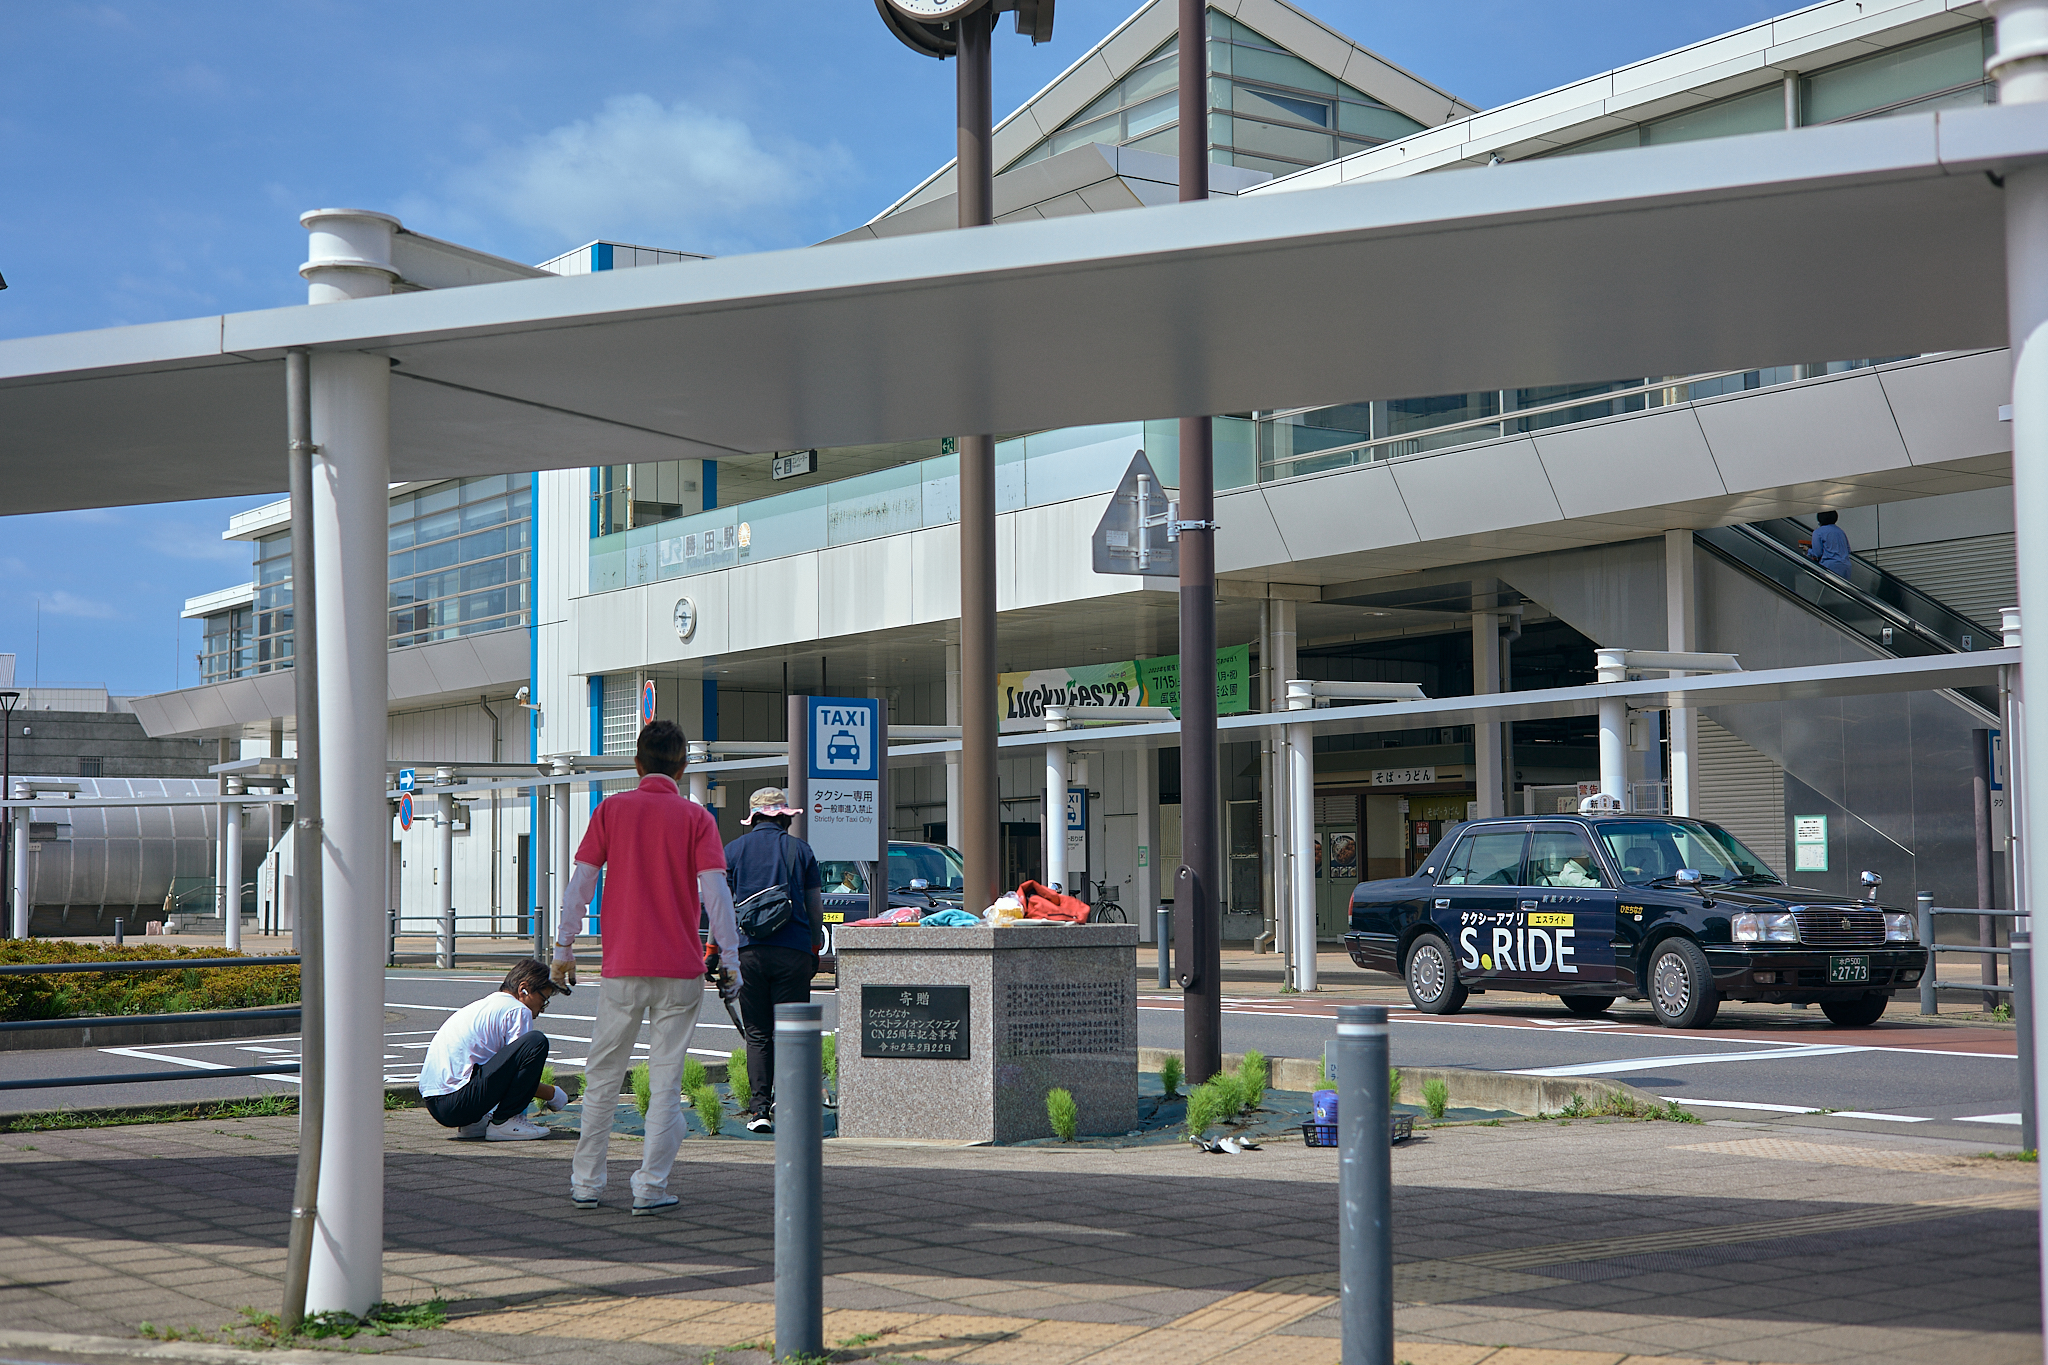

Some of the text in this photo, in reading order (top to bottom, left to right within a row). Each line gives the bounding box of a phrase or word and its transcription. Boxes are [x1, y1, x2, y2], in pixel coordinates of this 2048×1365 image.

[685, 525, 735, 557] 勝田駅
[660, 537, 684, 566] JR
[820, 709, 865, 727] TAXI
[1375, 769, 1431, 784] そば・うどん
[814, 790, 873, 802] タクシー専用
[1578, 784, 1599, 796] 警告
[823, 804, 873, 815] 一般車進入禁止
[814, 815, 873, 825] Strictly for Taxi Only
[1460, 911, 1566, 926] タクシーアプリ エスライド
[1459, 926, 1579, 974] S.RIDE
[1838, 965, 1867, 980] 27-73
[899, 990, 930, 1007] 寄贈
[868, 1008, 910, 1019] ひたちなか
[868, 1019, 961, 1029] ベストライオンズクラブ
[878, 1041, 952, 1053] 令和2年2月22日
